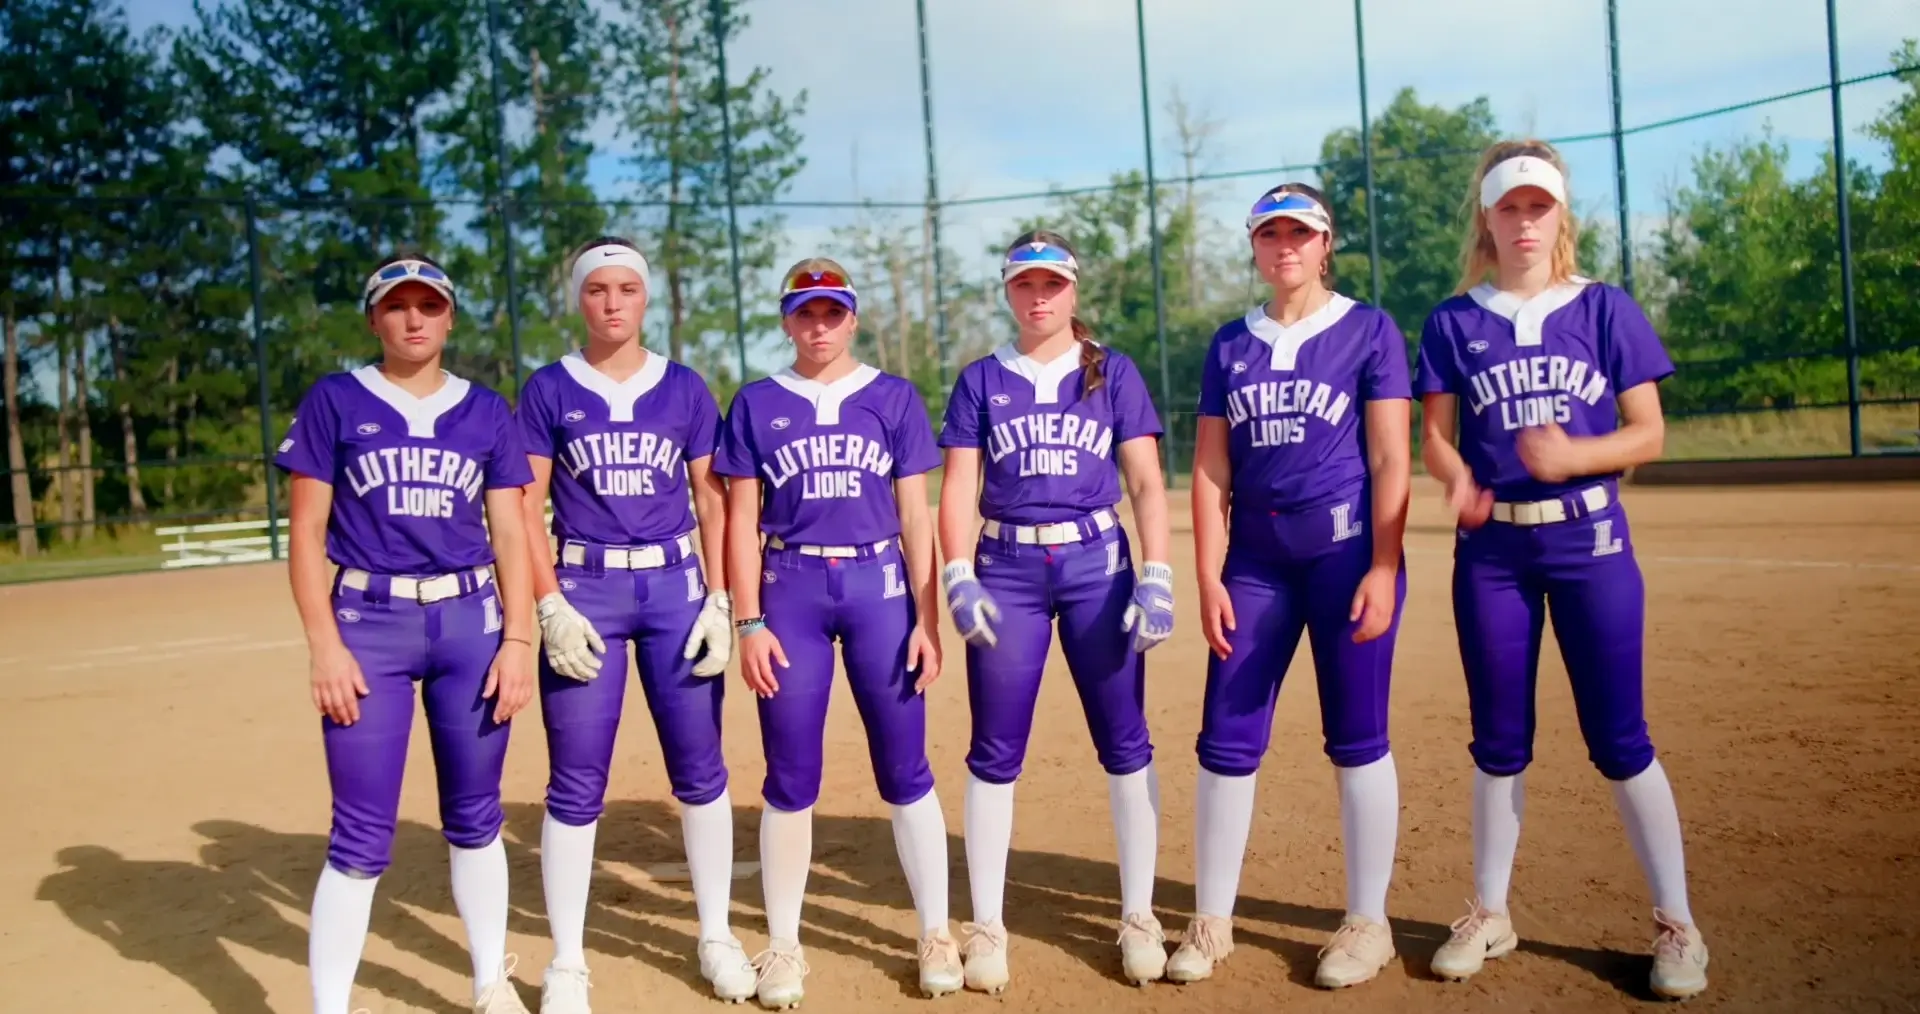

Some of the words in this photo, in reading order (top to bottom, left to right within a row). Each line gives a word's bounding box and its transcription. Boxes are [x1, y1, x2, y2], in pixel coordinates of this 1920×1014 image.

[1516, 161, 1529, 173] L
[1467, 356, 1608, 416] LUTHERAN
[1226, 379, 1350, 430] LUTHERAN
[1501, 394, 1571, 430] LIONS
[987, 413, 1113, 463] LUTHERAN
[1250, 416, 1307, 448] LIONS
[761, 434, 893, 488] LUTHERAN
[1019, 448, 1078, 477] LIONS
[593, 469, 656, 496] LIONS
[802, 471, 862, 499] LIONS
[387, 485, 455, 518] LIONS
[1330, 503, 1362, 542] L
[1592, 519, 1623, 557] L
[1105, 540, 1128, 576] L
[685, 566, 706, 602] L
[883, 562, 906, 599] L
